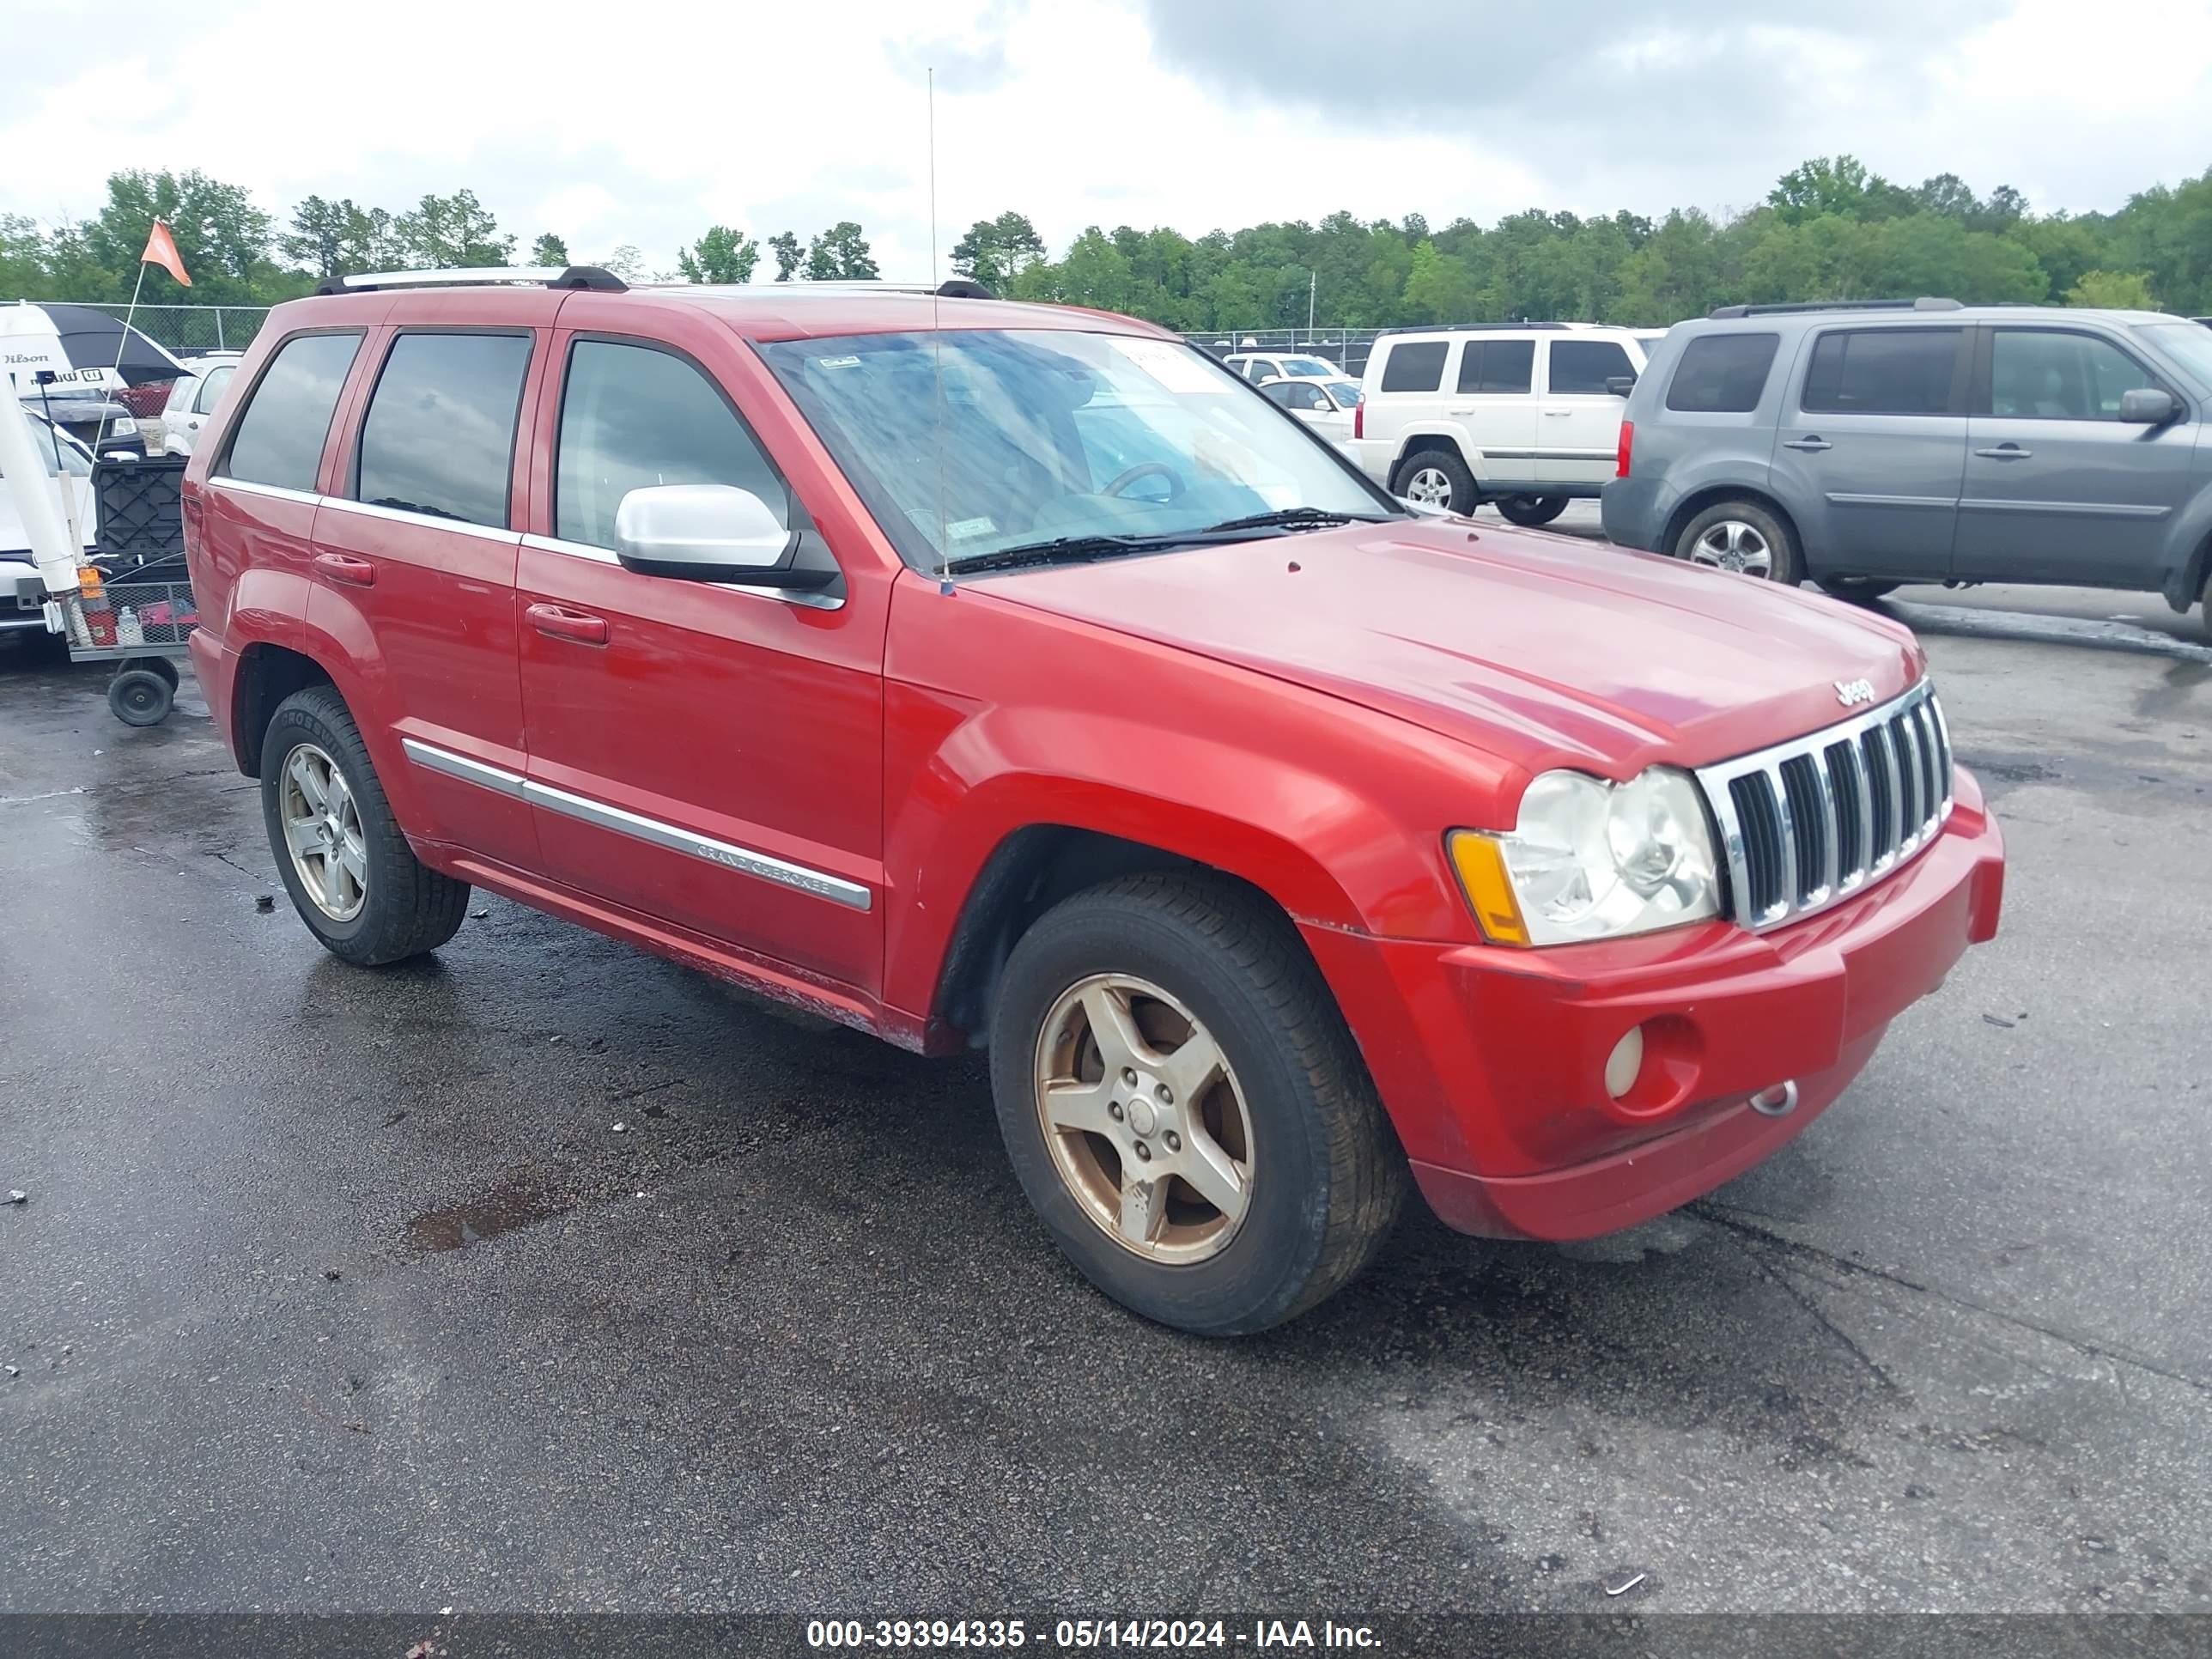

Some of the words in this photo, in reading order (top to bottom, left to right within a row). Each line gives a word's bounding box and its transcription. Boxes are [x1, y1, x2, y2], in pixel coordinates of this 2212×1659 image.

[1834, 678, 1875, 707] Jeep
[697, 844, 749, 870] GRAND
[751, 862, 830, 895] CHEROKEE
